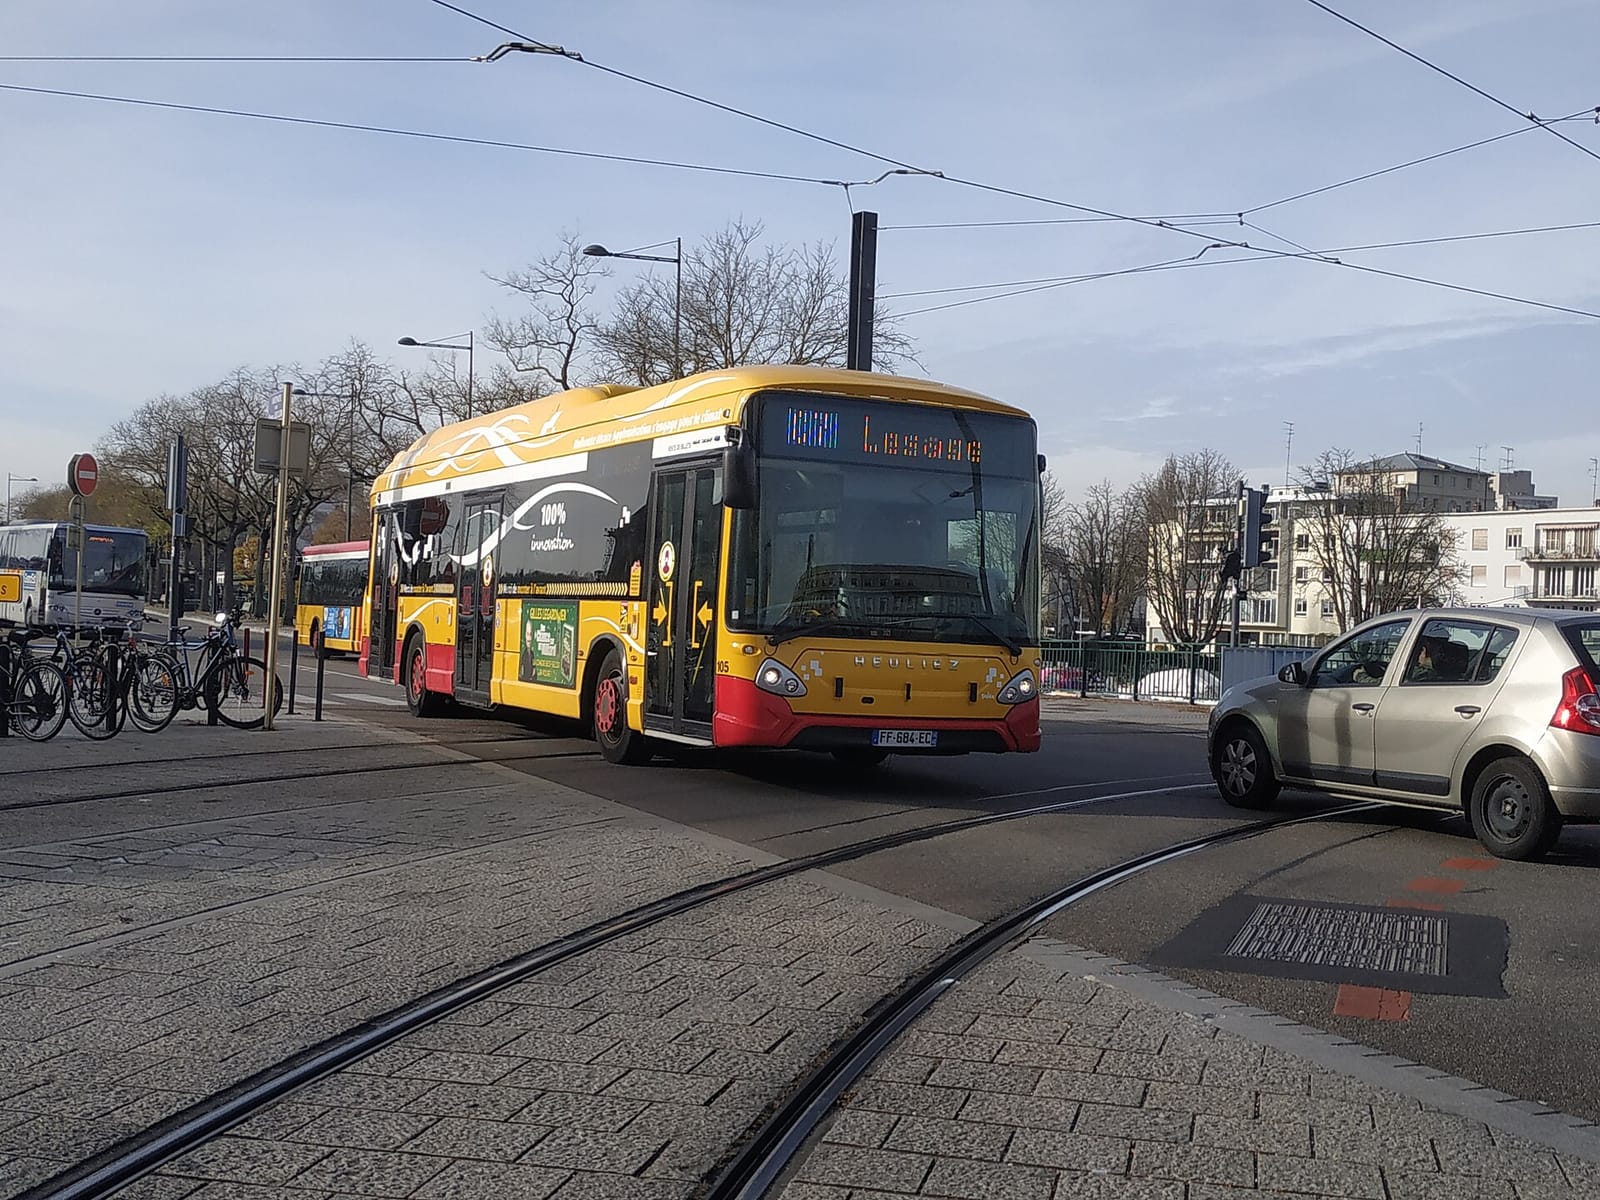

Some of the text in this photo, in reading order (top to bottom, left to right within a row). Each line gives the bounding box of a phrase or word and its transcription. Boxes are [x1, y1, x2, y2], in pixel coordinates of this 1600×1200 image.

[541, 503, 566, 526] 100%
[530, 527, 574, 551] innovation
[717, 661, 729, 673] 105
[854, 656, 960, 671] HEULIEZ
[879, 731, 932, 744] FF-684-EC
